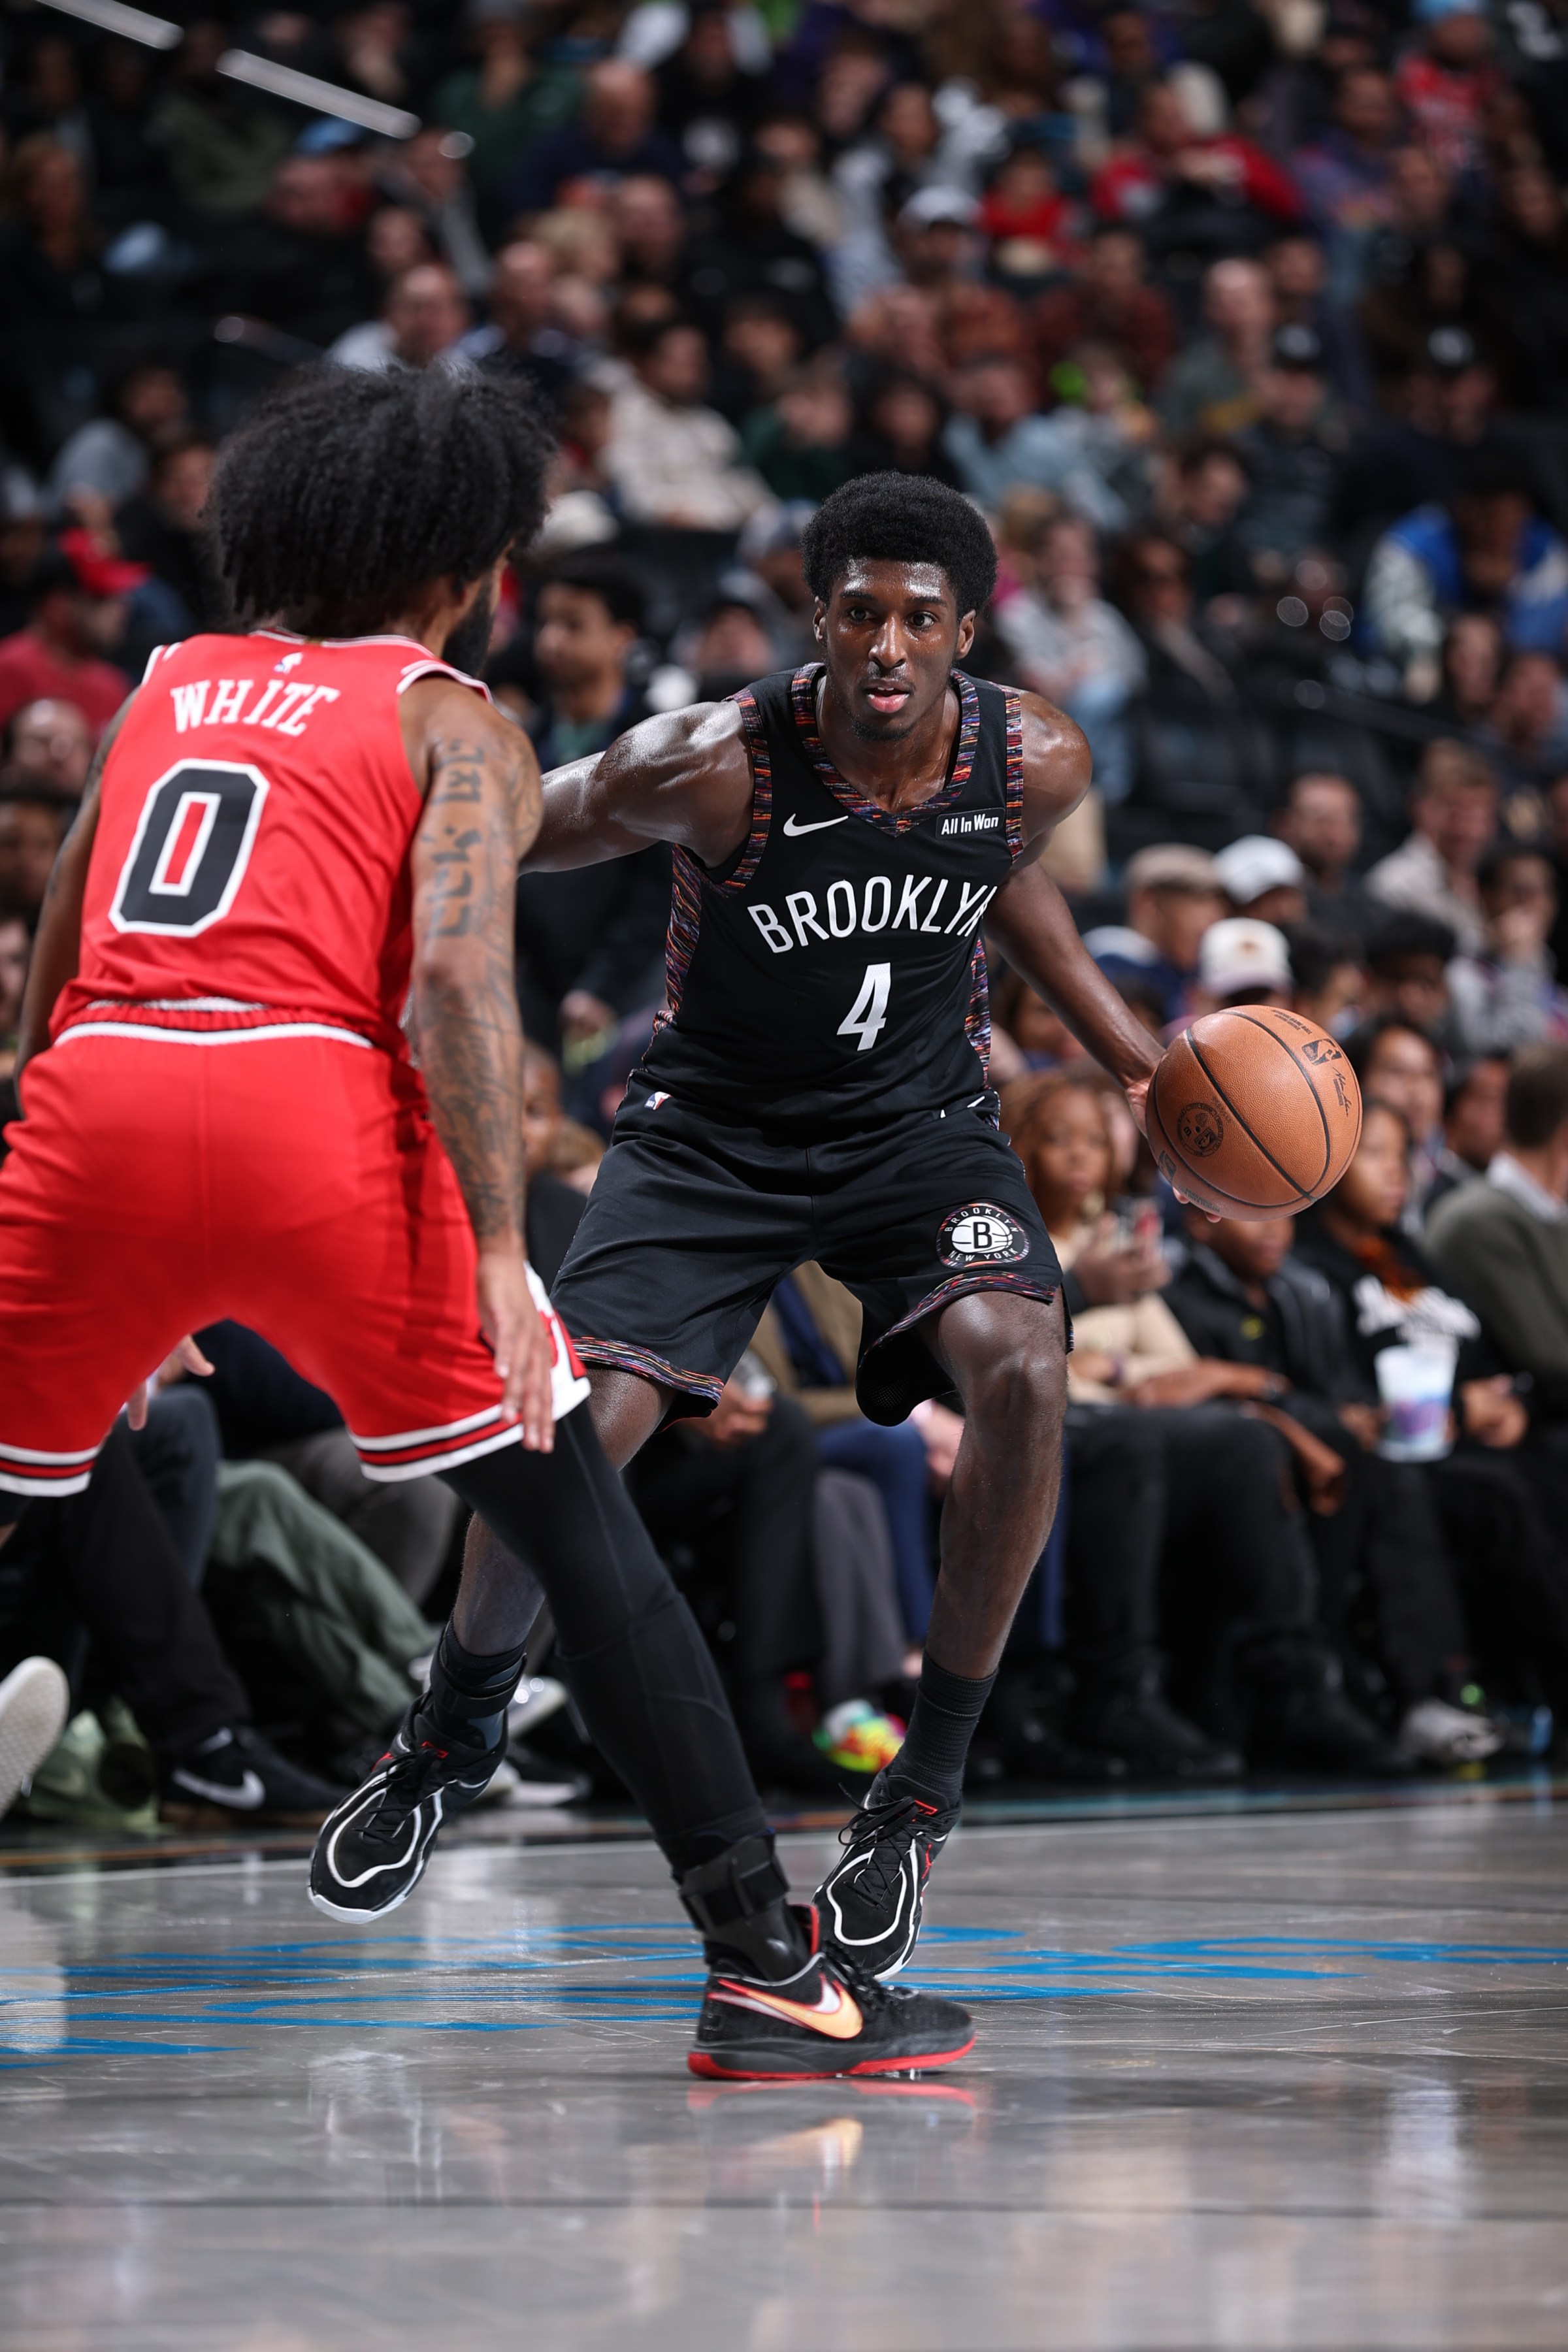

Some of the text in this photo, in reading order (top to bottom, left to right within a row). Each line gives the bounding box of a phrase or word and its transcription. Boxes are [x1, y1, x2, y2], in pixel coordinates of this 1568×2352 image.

[171, 679, 340, 736] WHITE
[941, 813, 999, 835] All In Won
[108, 758, 270, 938] 0
[836, 962, 891, 1051] 4
[944, 1207, 1019, 1232] BROOKLYN
[973, 1221, 992, 1249] B
[948, 1247, 1018, 1262] NEW YORK
